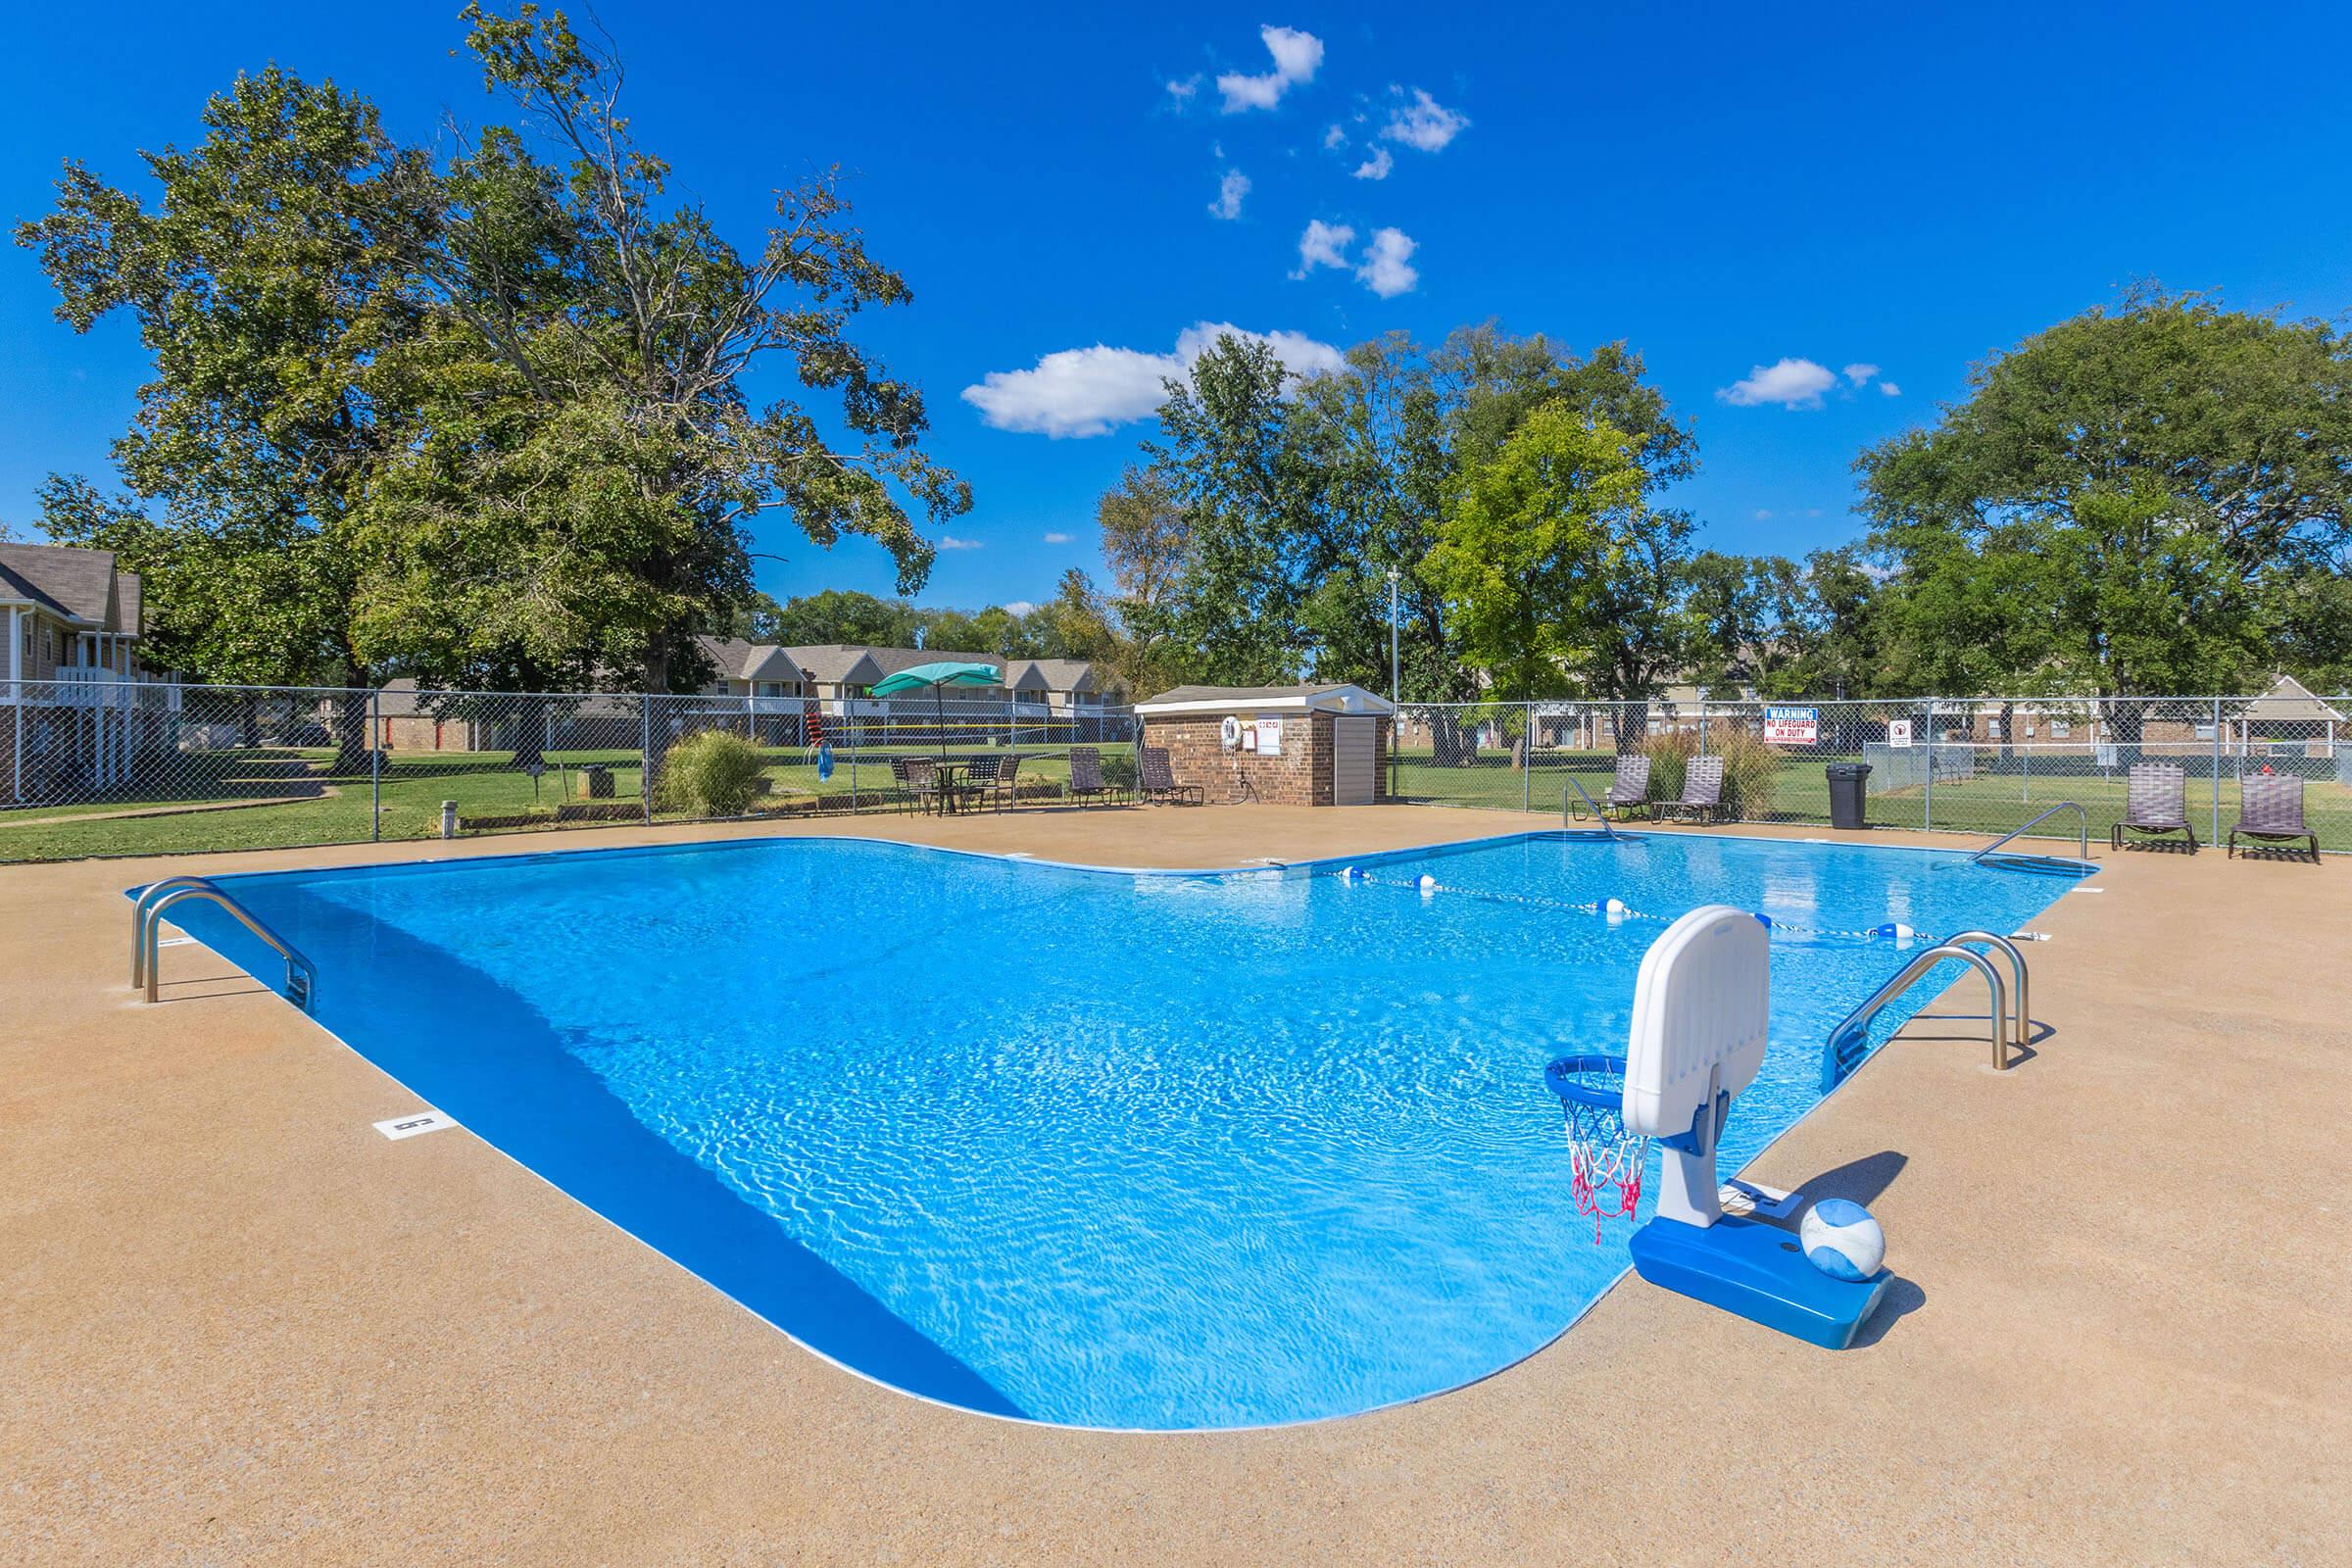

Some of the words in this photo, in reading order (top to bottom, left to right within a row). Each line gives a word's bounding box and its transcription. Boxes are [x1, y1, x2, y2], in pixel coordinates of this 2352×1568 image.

[1770, 709, 1814, 720] WARNING
[1767, 719, 1776, 728] NO
[1779, 719, 1816, 729] LIFEGUARD
[1776, 728, 1785, 737] ON
[1788, 728, 1805, 737] DUTY
